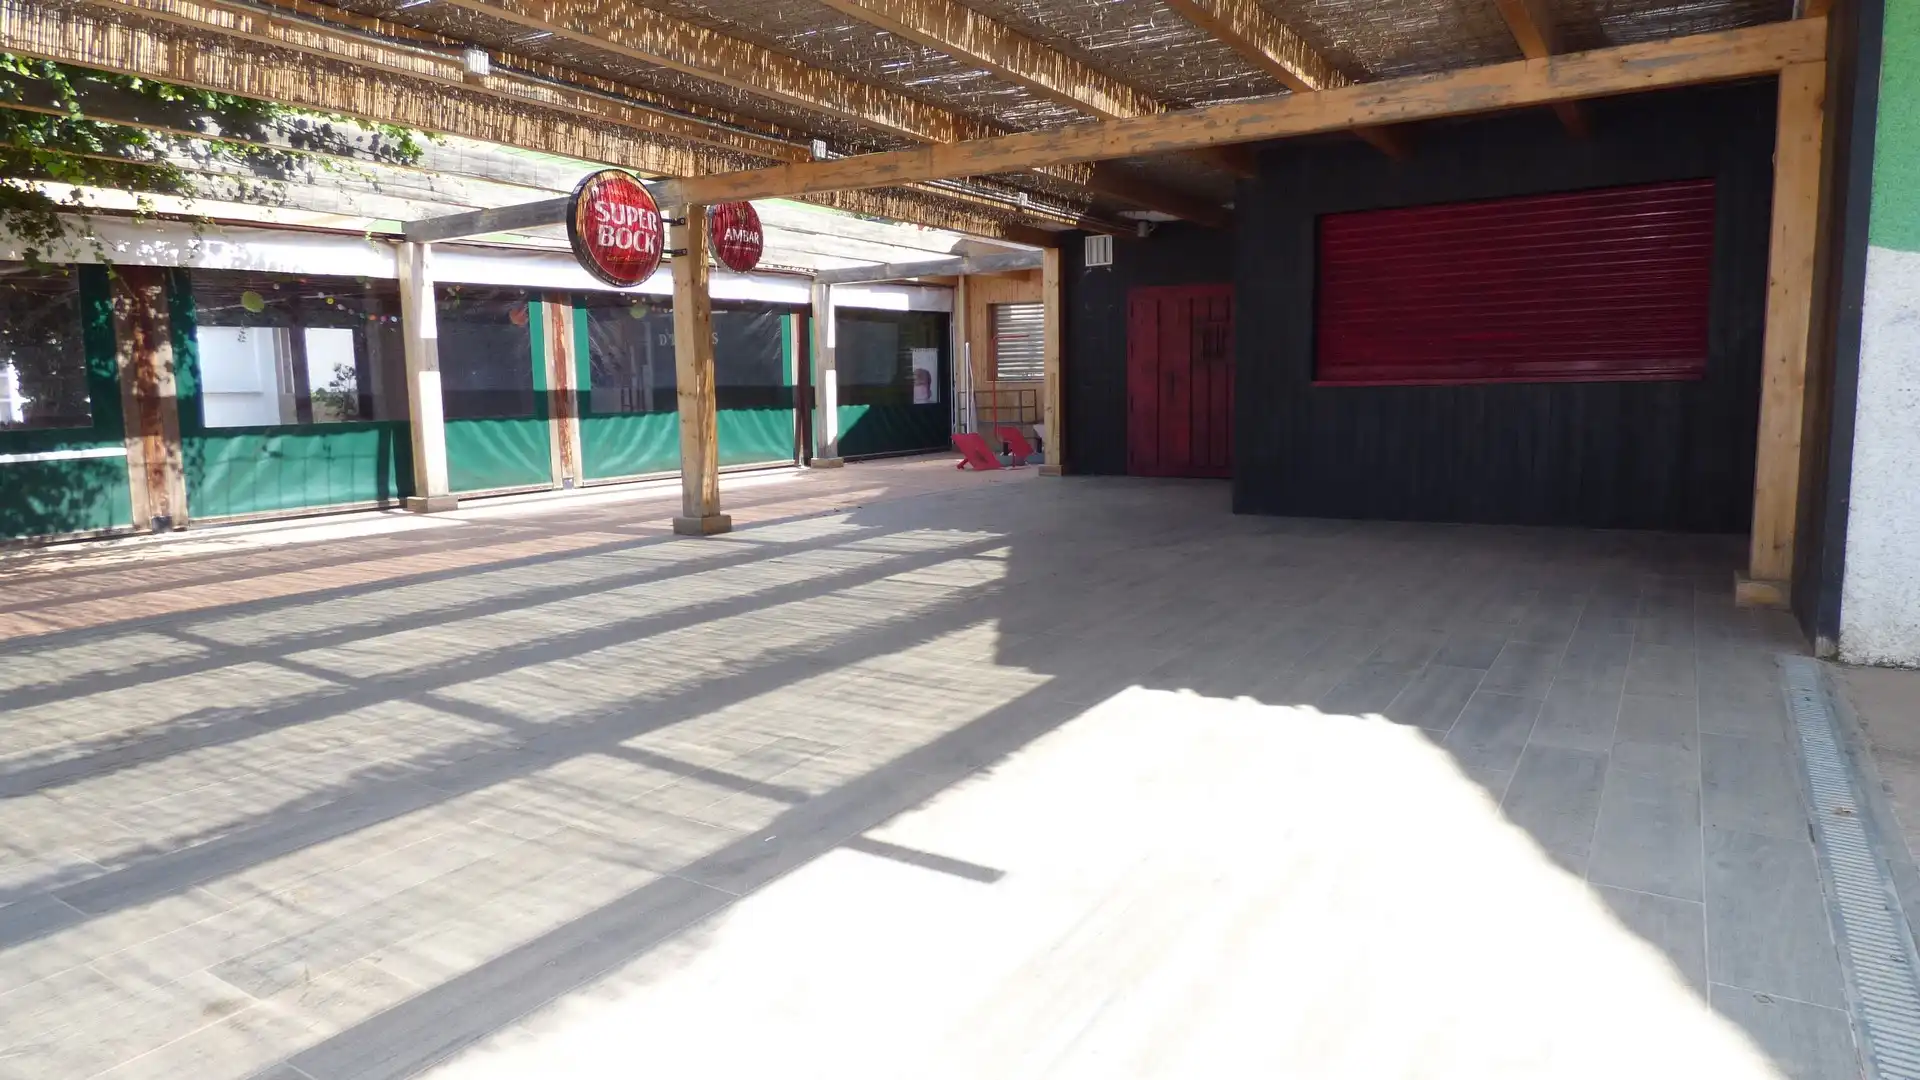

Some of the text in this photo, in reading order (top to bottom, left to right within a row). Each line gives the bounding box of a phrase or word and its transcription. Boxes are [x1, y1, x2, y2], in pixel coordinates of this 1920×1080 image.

[595, 200, 657, 232] SUPER
[598, 223, 656, 254] BOCK
[724, 227, 759, 245] AMBAR
